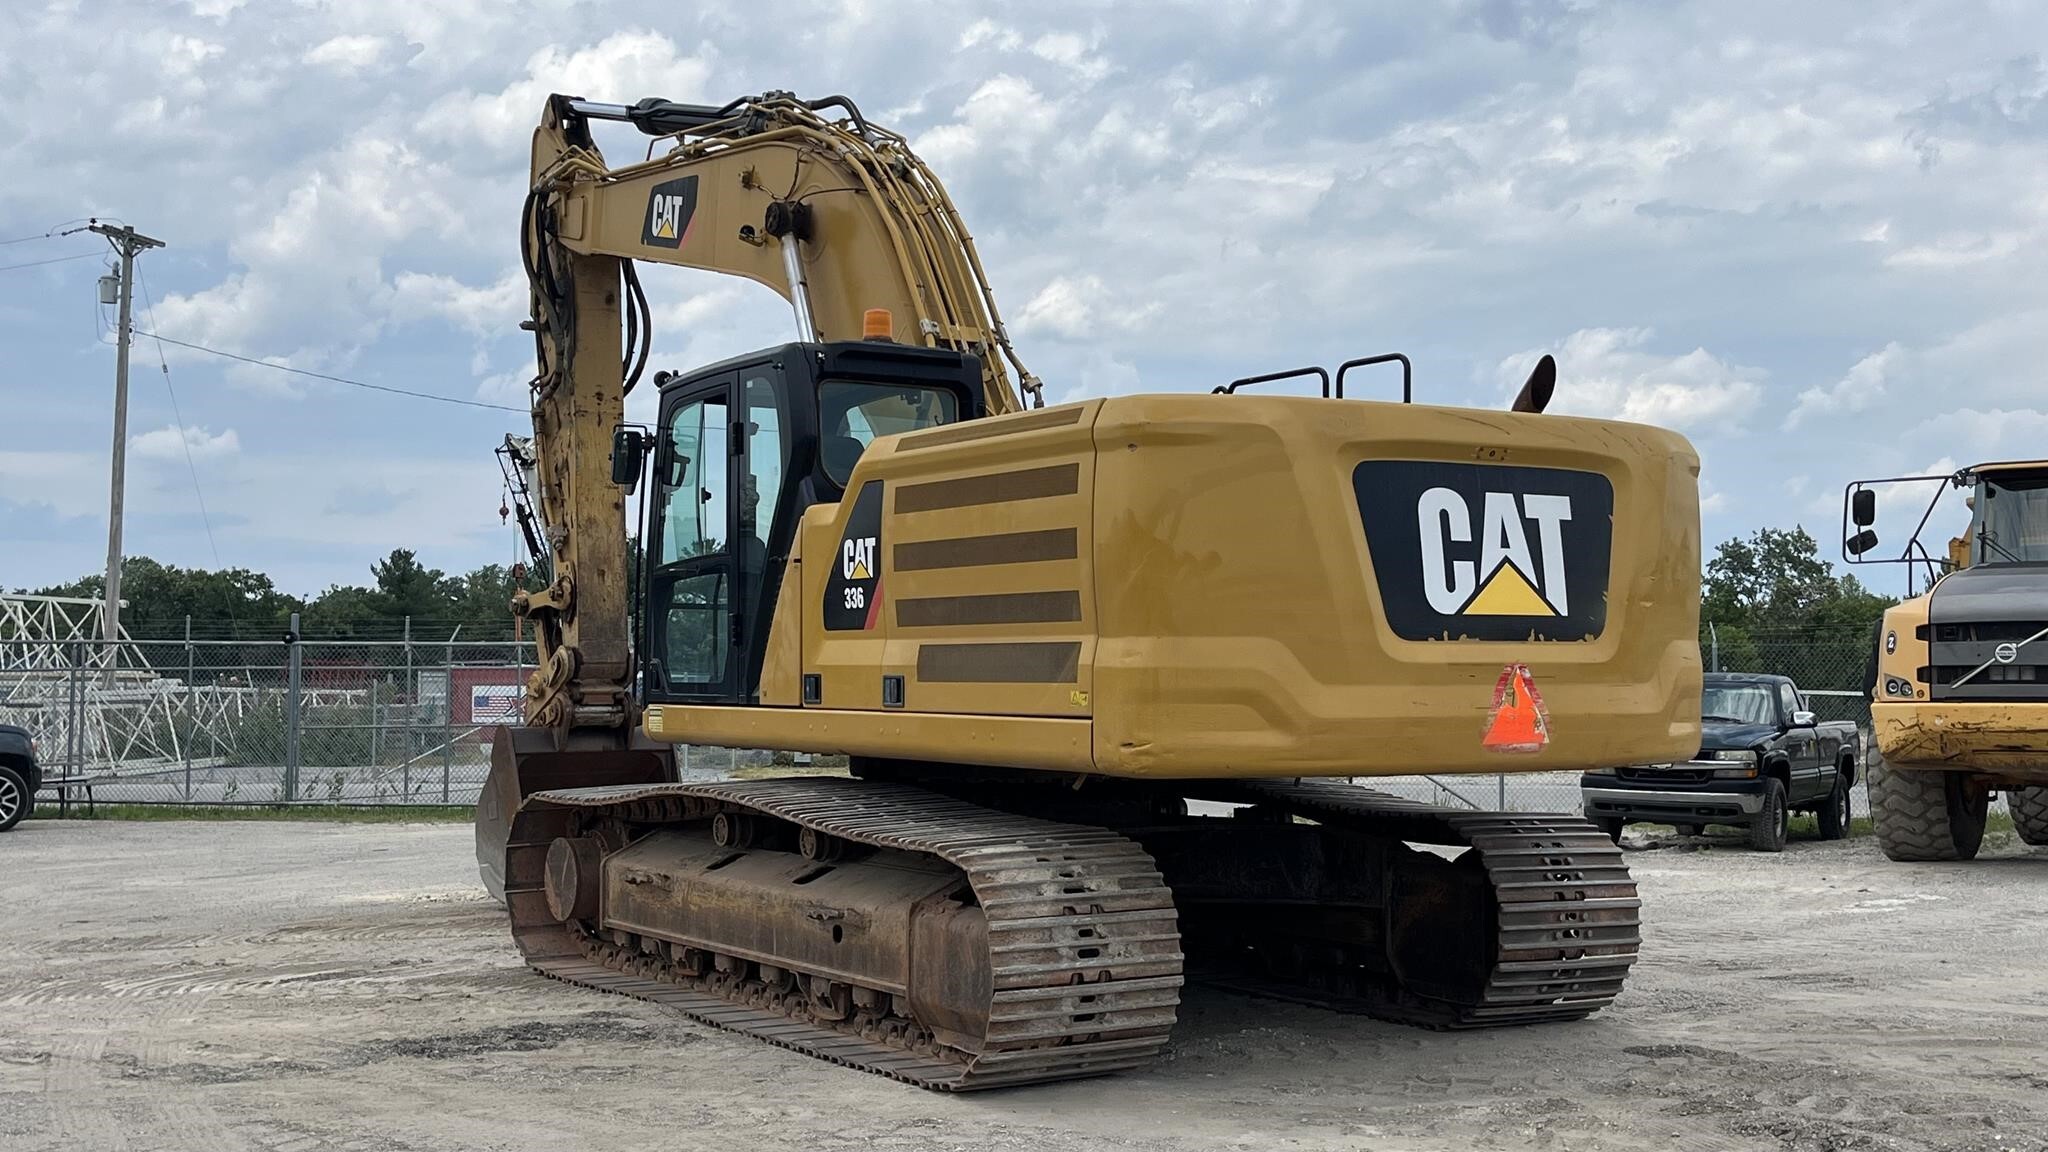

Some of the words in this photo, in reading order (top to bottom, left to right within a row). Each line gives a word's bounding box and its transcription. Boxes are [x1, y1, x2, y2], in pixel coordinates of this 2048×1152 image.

[651, 193, 683, 239] CAT
[843, 537, 876, 580] CAT
[1417, 487, 1572, 616] CAT
[844, 587, 864, 609] 336
